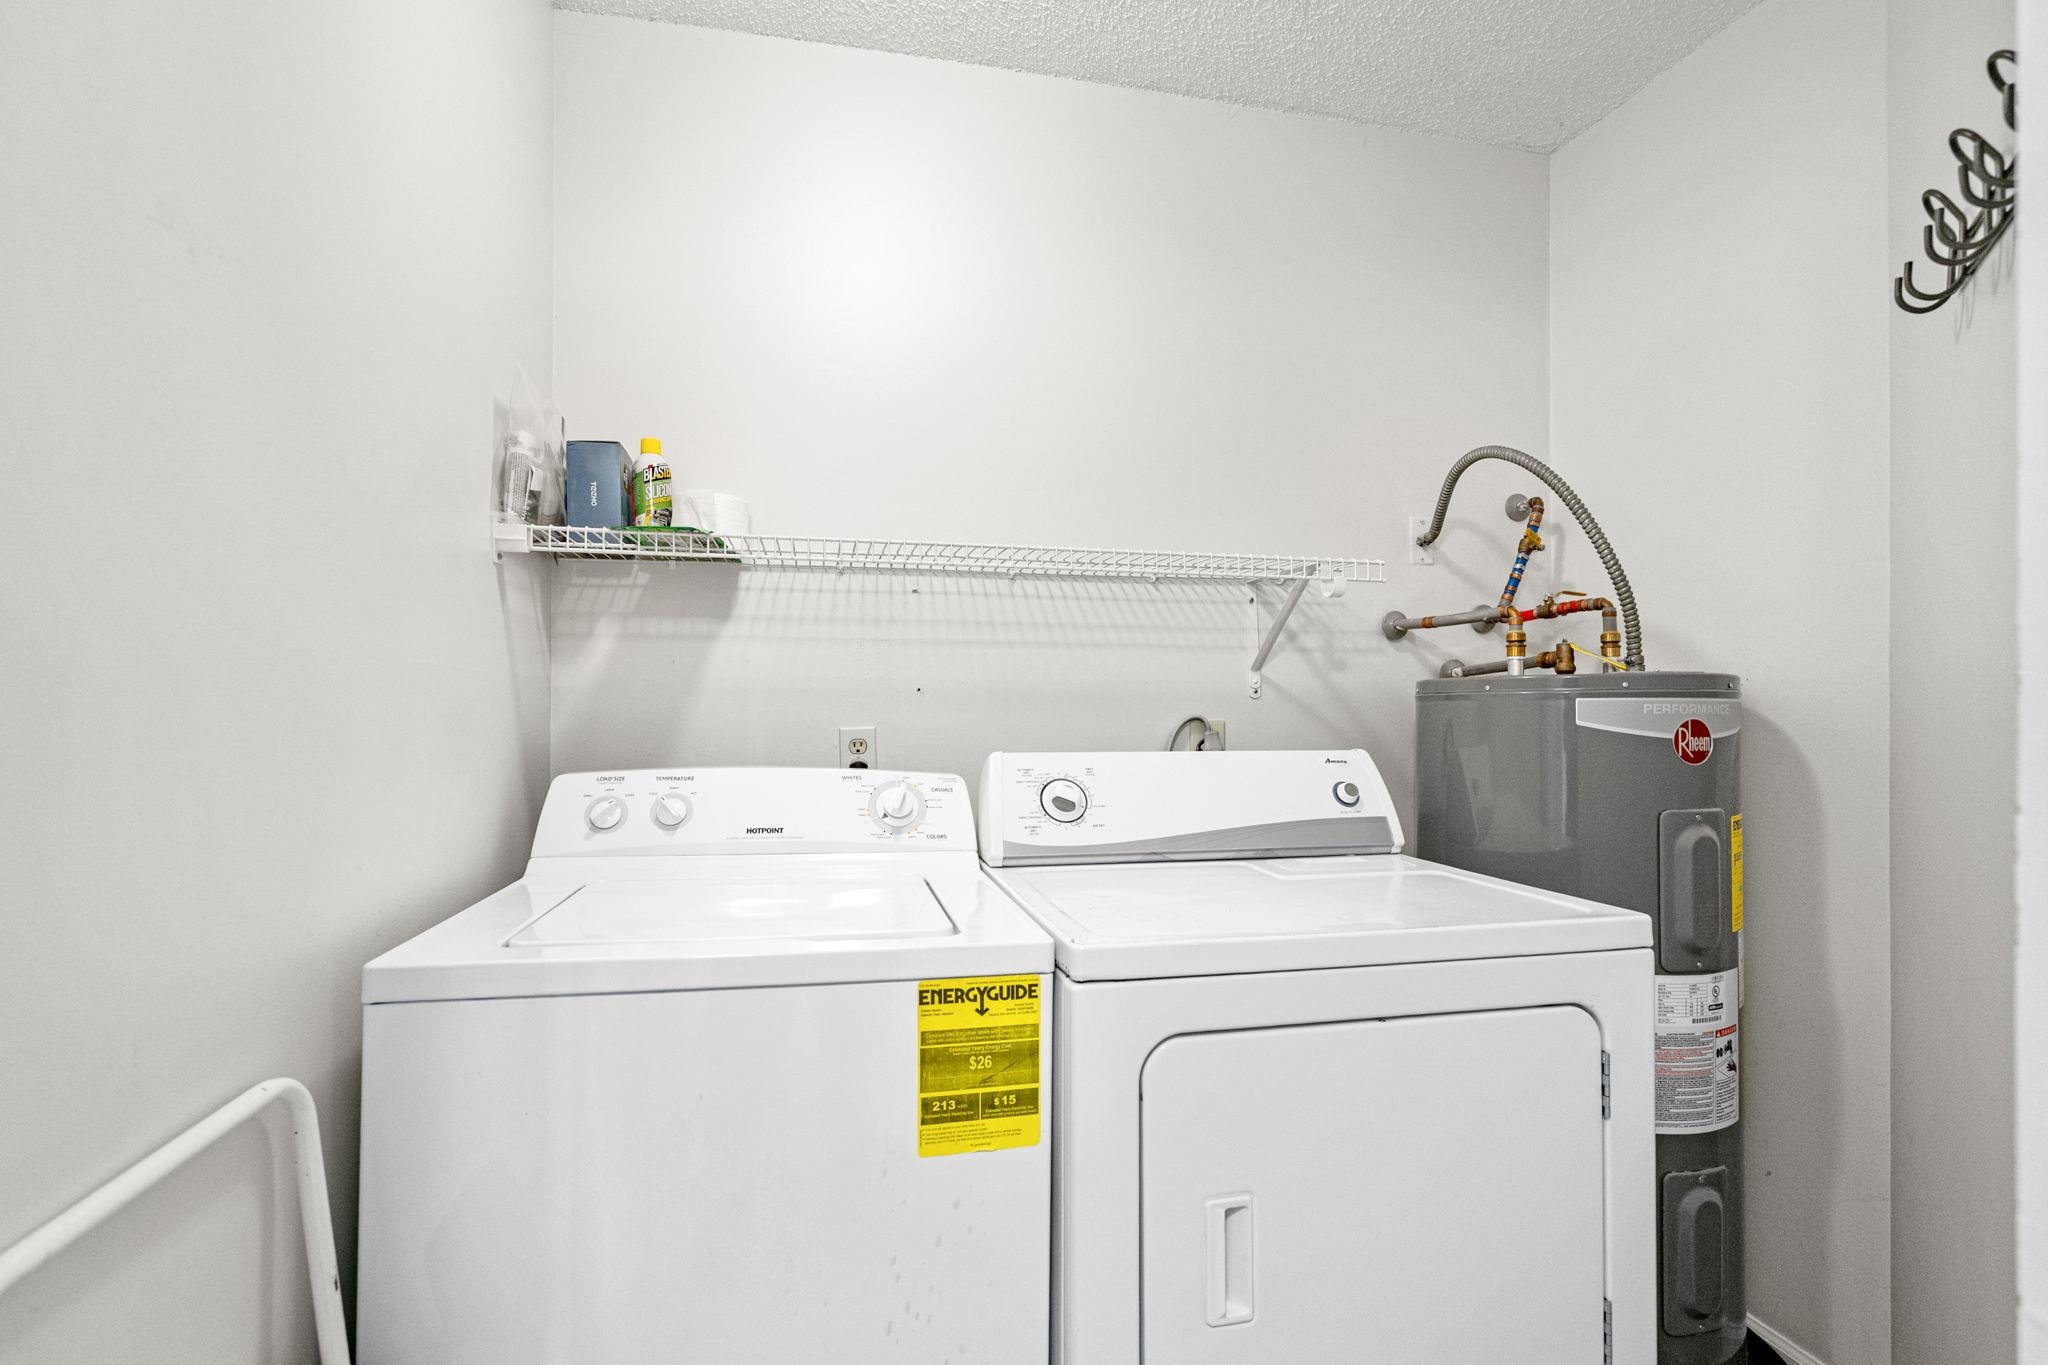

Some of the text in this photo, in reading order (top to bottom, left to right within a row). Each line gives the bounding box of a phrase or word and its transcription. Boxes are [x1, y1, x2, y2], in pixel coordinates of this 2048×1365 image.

[1643, 703, 1730, 715] PERFORMANCE
[1679, 719, 1710, 758] Rheem
[969, 1055, 992, 1071] $26
[932, 1100, 956, 1112] 213
